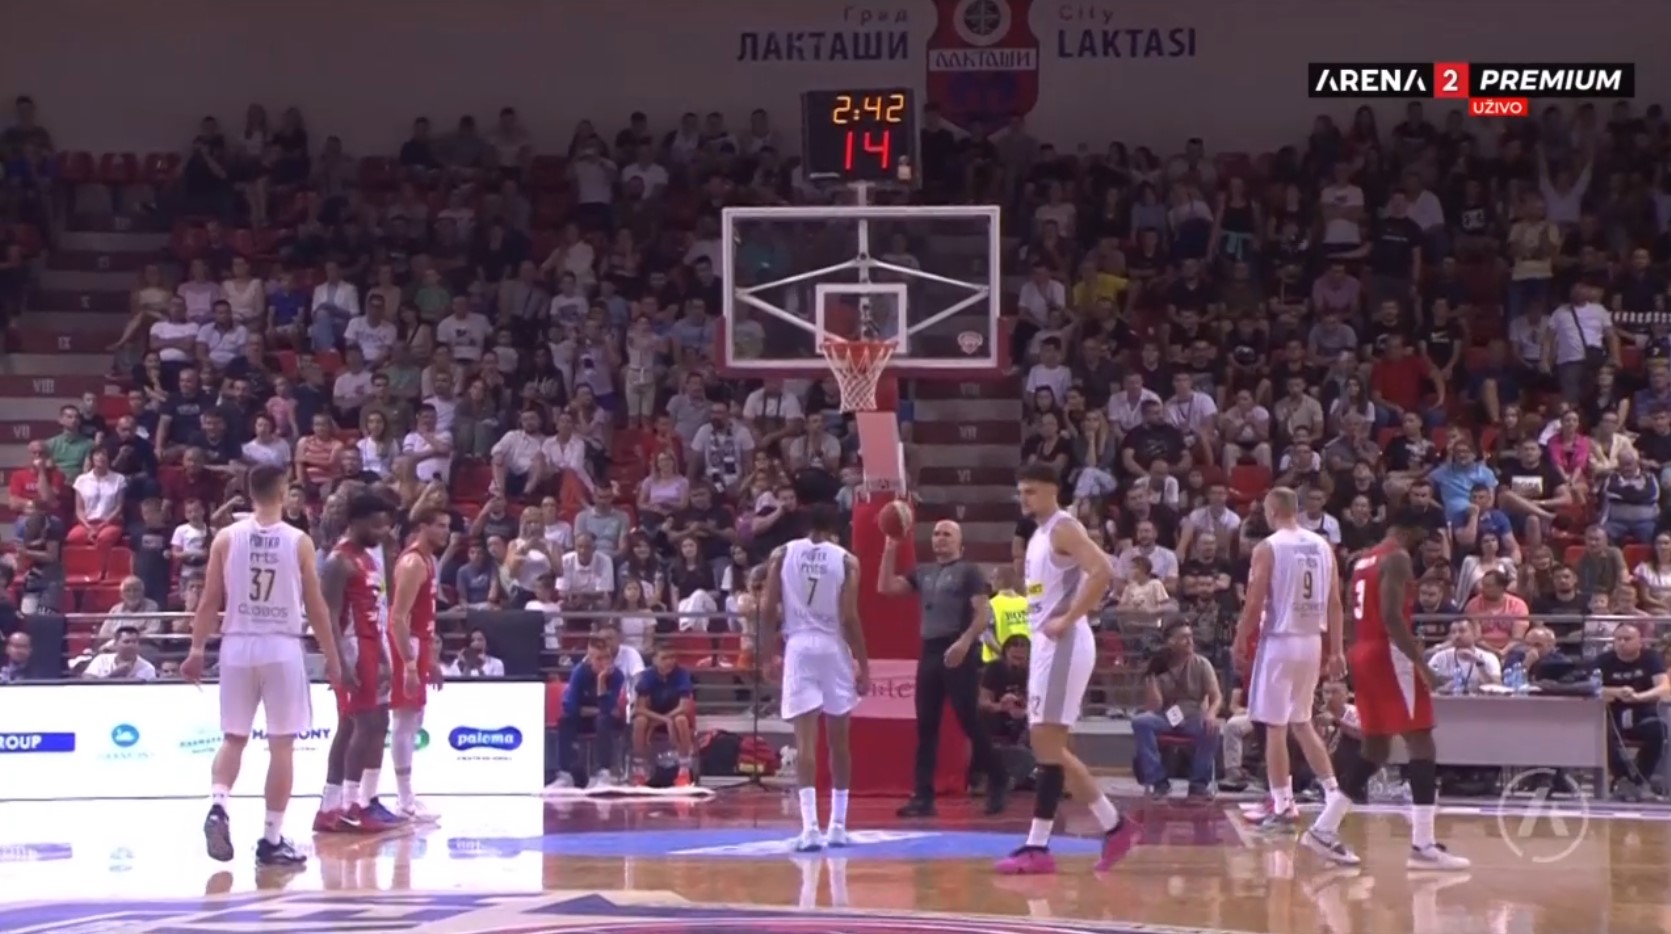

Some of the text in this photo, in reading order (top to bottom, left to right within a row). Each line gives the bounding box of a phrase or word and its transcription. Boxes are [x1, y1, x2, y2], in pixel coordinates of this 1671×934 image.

[1058, 4, 1114, 24] City
[737, 31, 908, 62] ЛАКТАШИ
[1058, 27, 1196, 58] LAKTASI
[832, 93, 905, 125] 2:42
[844, 129, 891, 171] 14
[957, 469, 971, 482] VI
[955, 504, 966, 520] V
[249, 567, 277, 602] 37
[807, 577, 819, 607] 7
[1302, 570, 1313, 600] 9
[1354, 578, 1367, 620] 3
[252, 729, 330, 740] HONY
[457, 731, 514, 747] paloma
